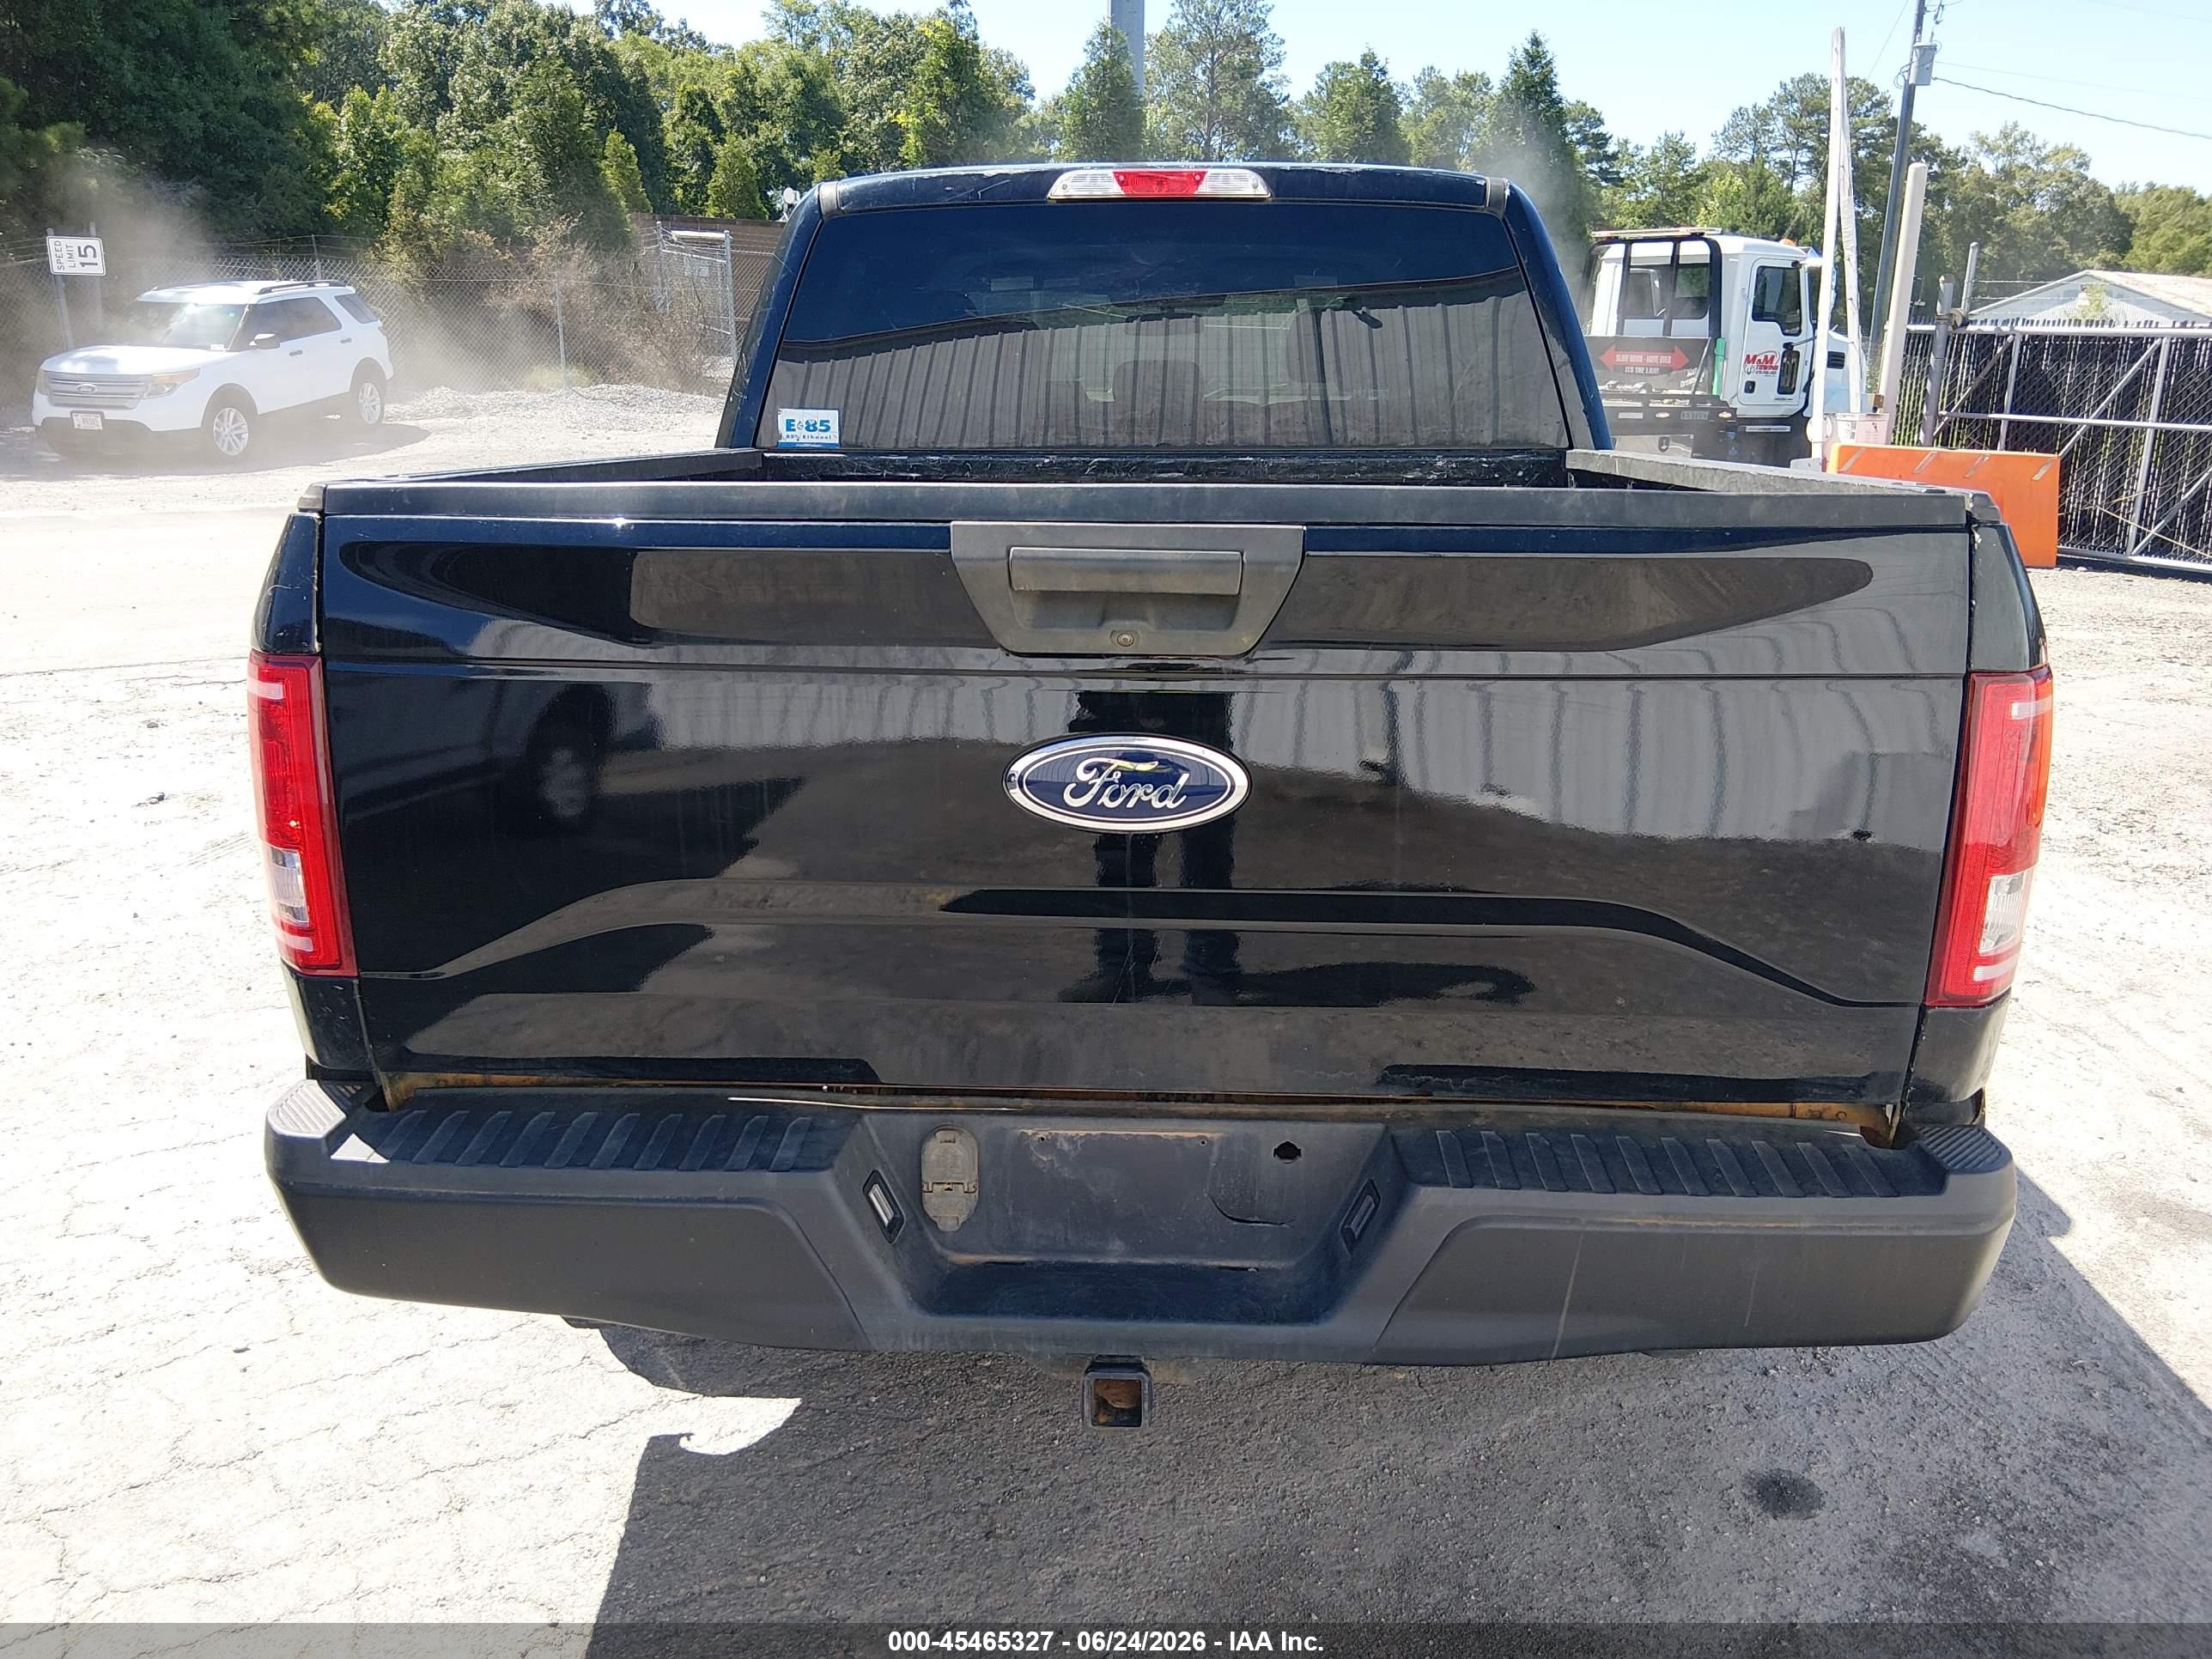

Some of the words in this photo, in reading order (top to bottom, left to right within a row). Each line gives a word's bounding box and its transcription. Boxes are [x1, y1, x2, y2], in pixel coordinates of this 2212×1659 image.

[54, 240, 65, 271] SPEED
[66, 244, 76, 268] LIMIT
[77, 245, 99, 267] 15
[1062, 757, 1190, 809] Ford
